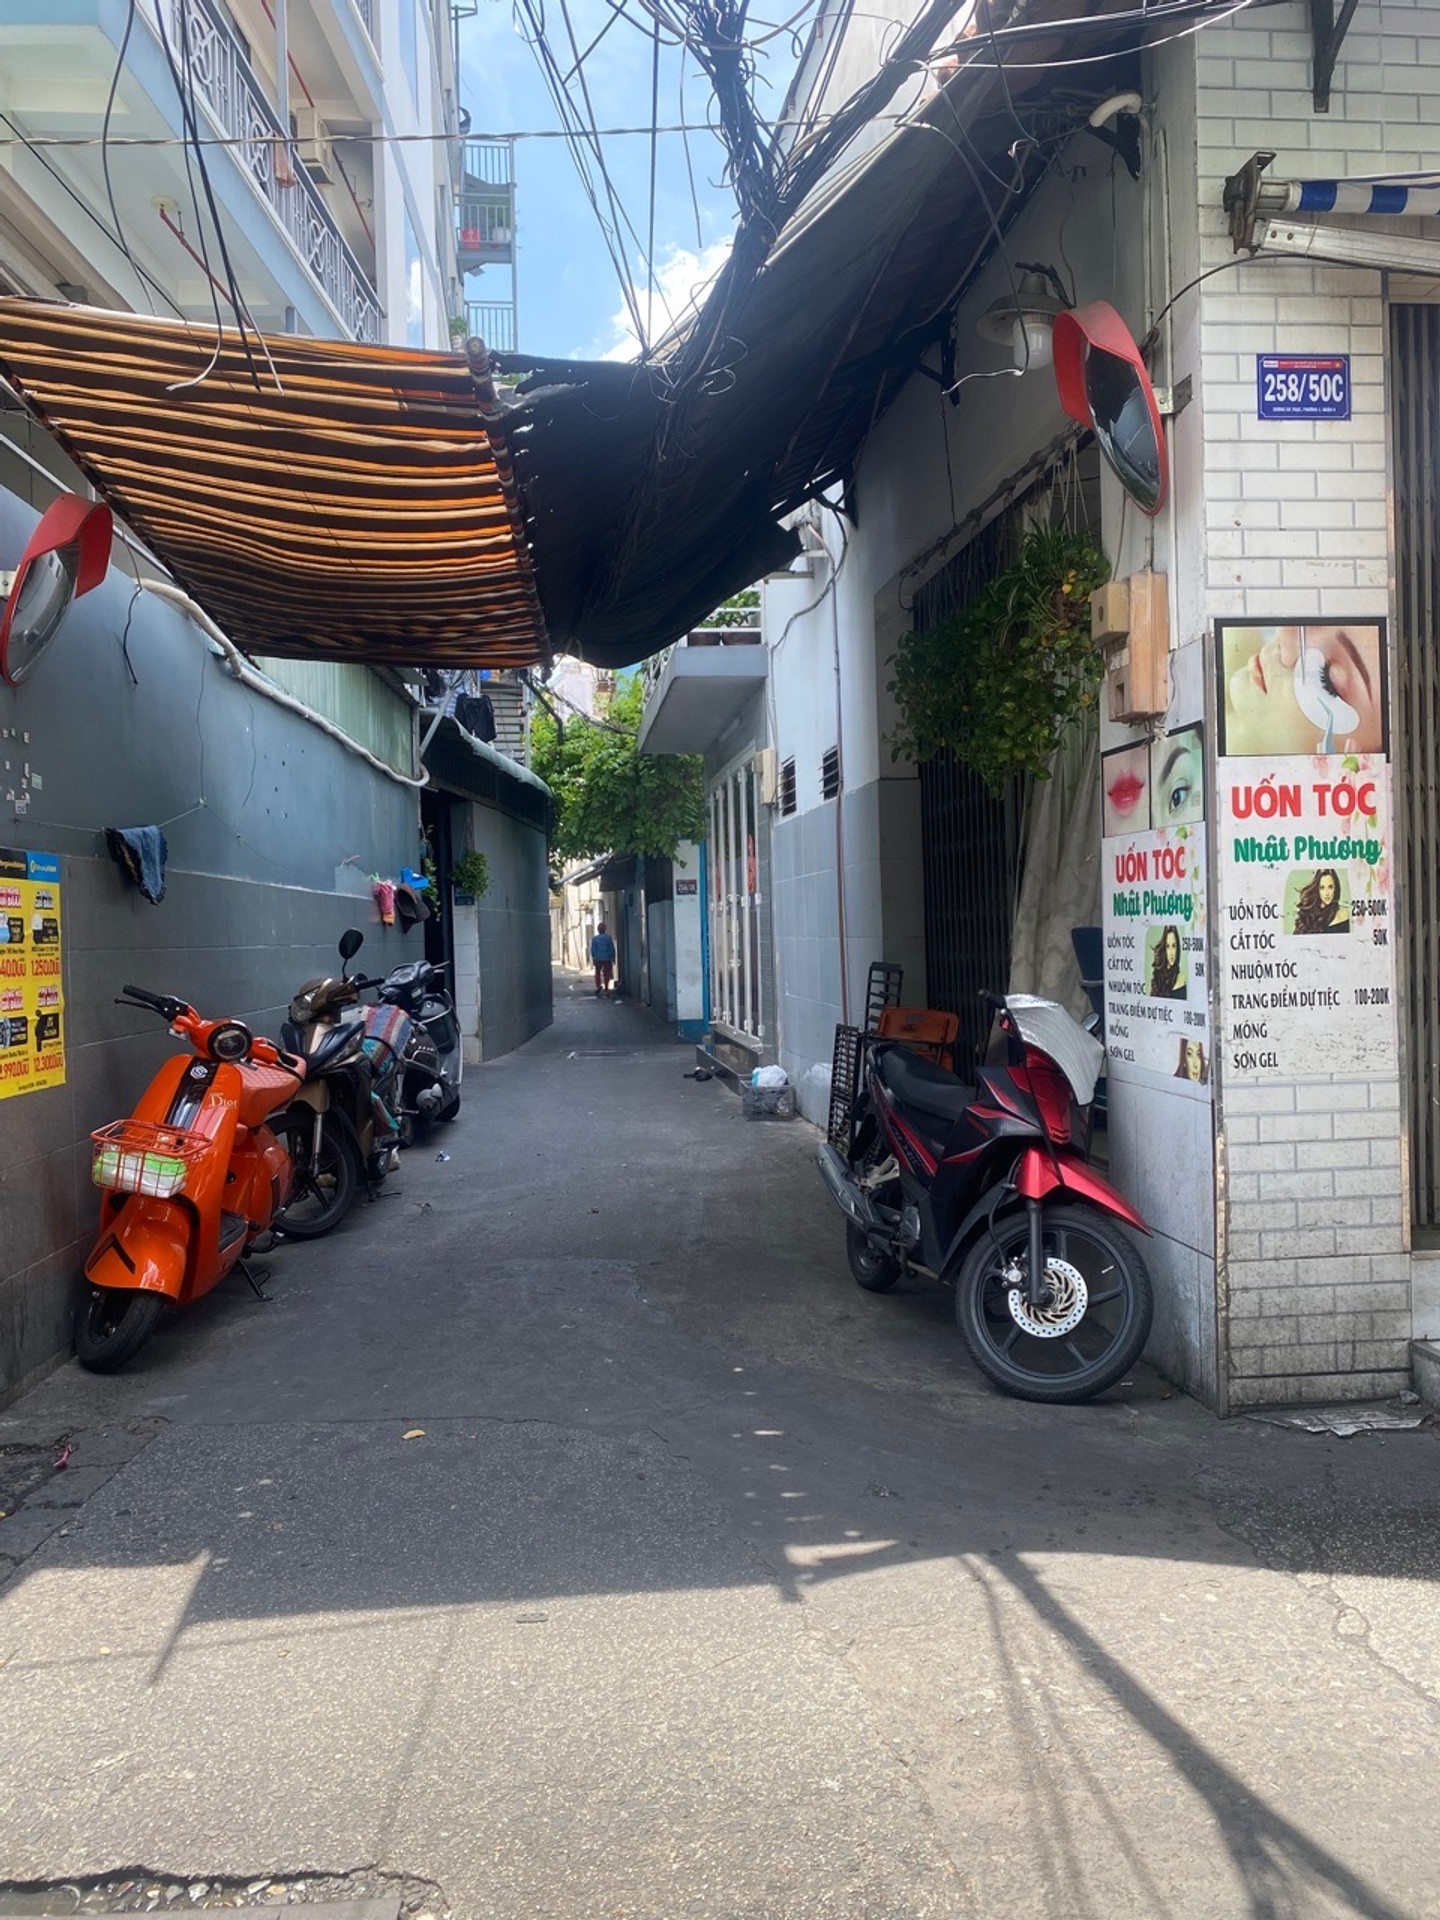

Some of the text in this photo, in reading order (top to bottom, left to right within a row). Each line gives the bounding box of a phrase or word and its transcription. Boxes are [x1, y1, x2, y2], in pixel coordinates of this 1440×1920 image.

[1264, 373, 1343, 402] 258/50C
[1231, 773, 1377, 819] UỐN TÓC
[1115, 841, 1186, 883] UỐN TÓC
[1233, 834, 1382, 869] Nhật Phương
[1113, 889, 1194, 923] Nhật Phương
[1256, 900, 1279, 919] TÓC
[1351, 899, 1388, 917] 250-500K
[1230, 928, 1276, 950] CẮT TÓC
[1373, 929, 1388, 946] 50K
[1231, 959, 1298, 982] NHUỘM TÓC
[1132, 982, 1146, 996] TÓC
[1232, 985, 1341, 1011] TRANG ĐIỂM DỰ TIỆC
[1354, 987, 1390, 1006] 100-200K
[1232, 1019, 1268, 1039] MÓNG
[1233, 1050, 1279, 1069] SƠN GEL
[209, 1093, 238, 1109] Dior
